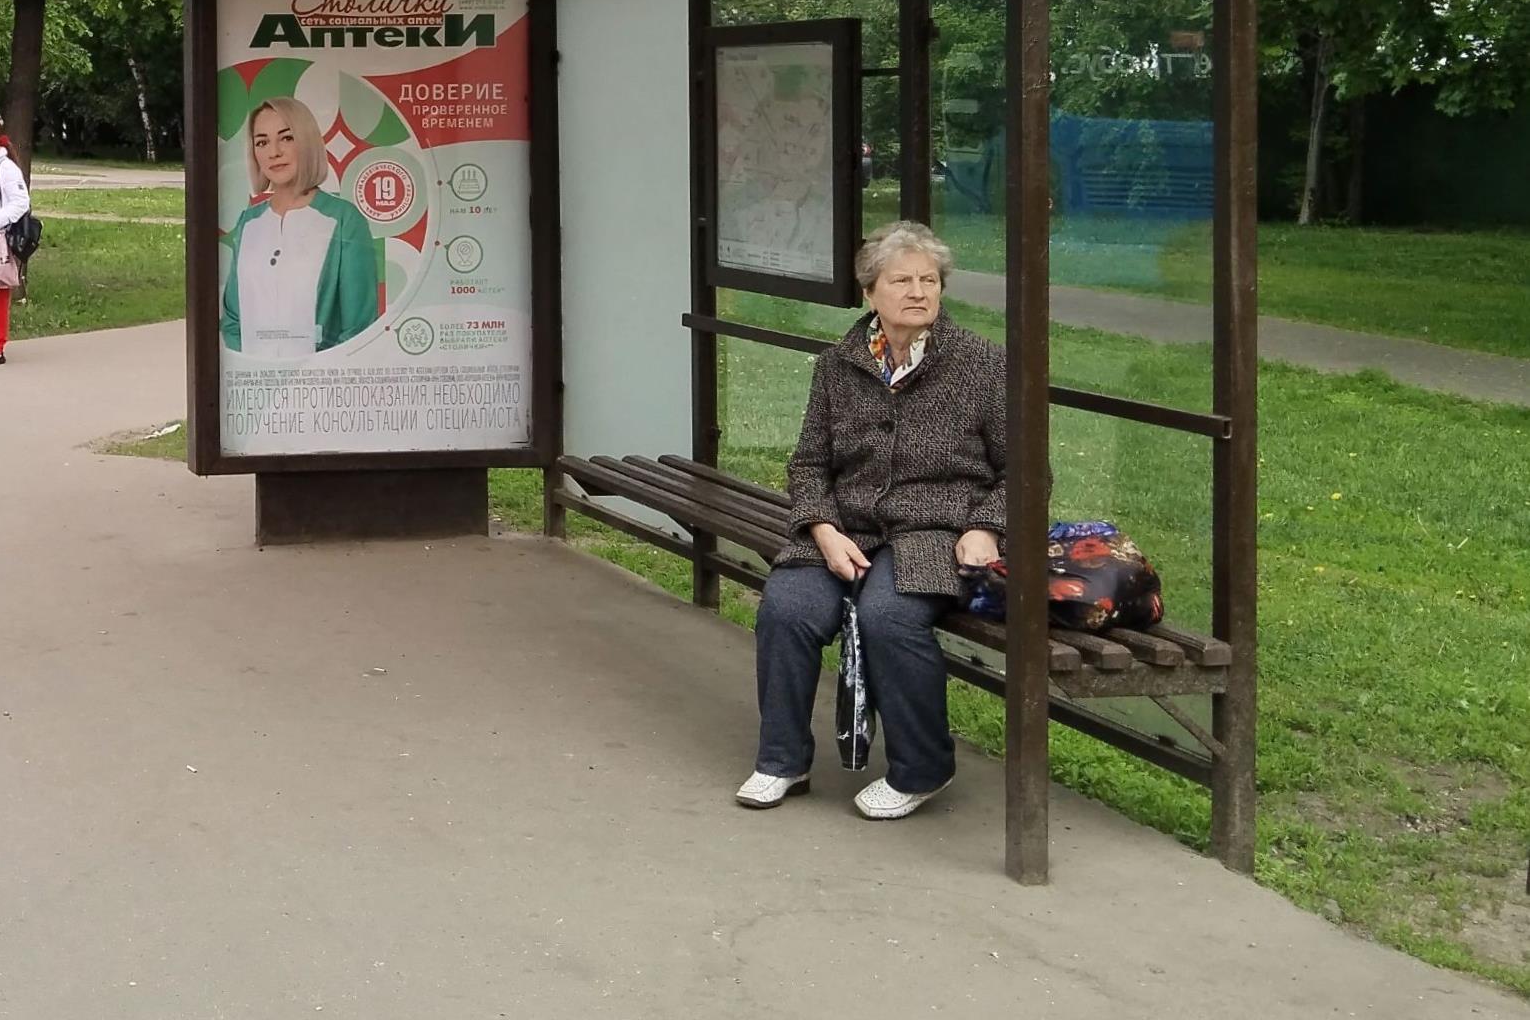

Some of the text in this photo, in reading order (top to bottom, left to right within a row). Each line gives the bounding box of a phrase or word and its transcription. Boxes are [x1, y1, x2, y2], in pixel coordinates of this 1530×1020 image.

[301, 17, 444, 27] сеть социальных аптек
[399, 83, 508, 104] ДОВЕРИЕ.
[413, 104, 508, 116] ПРОВЕРЕННОЕ
[422, 117, 494, 129] ВРЕМЕНЕМ
[372, 176, 396, 200] 19
[469, 206, 481, 214] 10
[451, 286, 475, 294] 1000
[466, 321, 479, 329] 73
[481, 320, 505, 329] МЛН
[226, 382, 520, 411] ИМЕЮТСЯ ПРОТИВОПОКАЗАНИЯ. НЕОБХОДИМО
[226, 406, 520, 435] ПОЛУЧЕНИЕ КОНСУЛЬТАЦИИ СПЕЦИАЛИСТА
